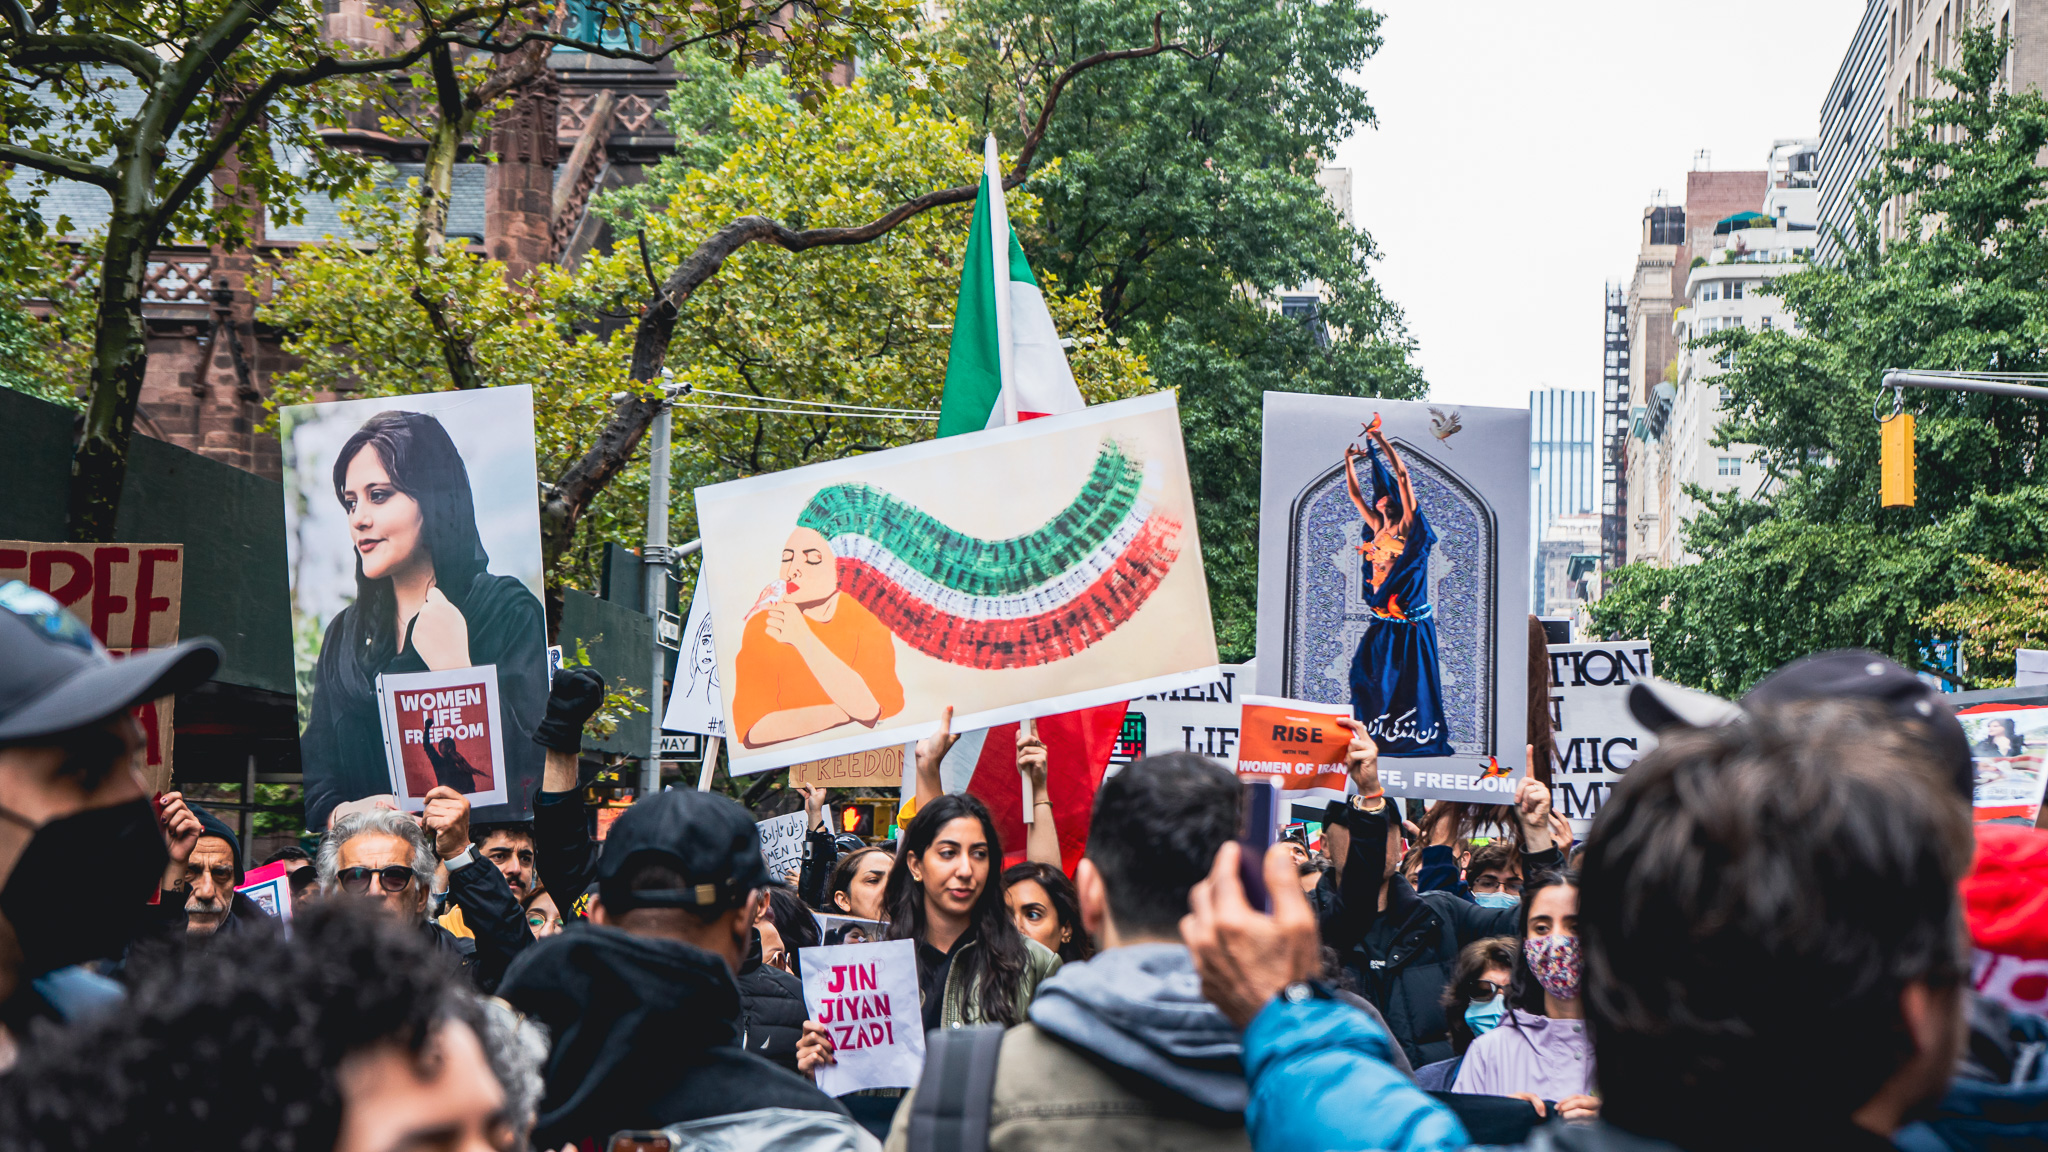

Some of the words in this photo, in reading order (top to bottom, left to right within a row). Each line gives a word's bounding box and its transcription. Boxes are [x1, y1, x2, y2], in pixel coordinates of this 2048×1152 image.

[0, 547, 179, 656] REE
[400, 687, 482, 712] WOMEN
[422, 707, 463, 728] LIFE
[404, 722, 484, 745] FREEDOM
[660, 737, 689, 750] WAY
[1271, 724, 1323, 744] RISE
[1238, 759, 1292, 774] WOMEN
[1294, 762, 1315, 775] OF
[1317, 762, 1348, 775] IRAN
[1413, 771, 1517, 794] FREEDOM
[827, 962, 878, 993] JIN
